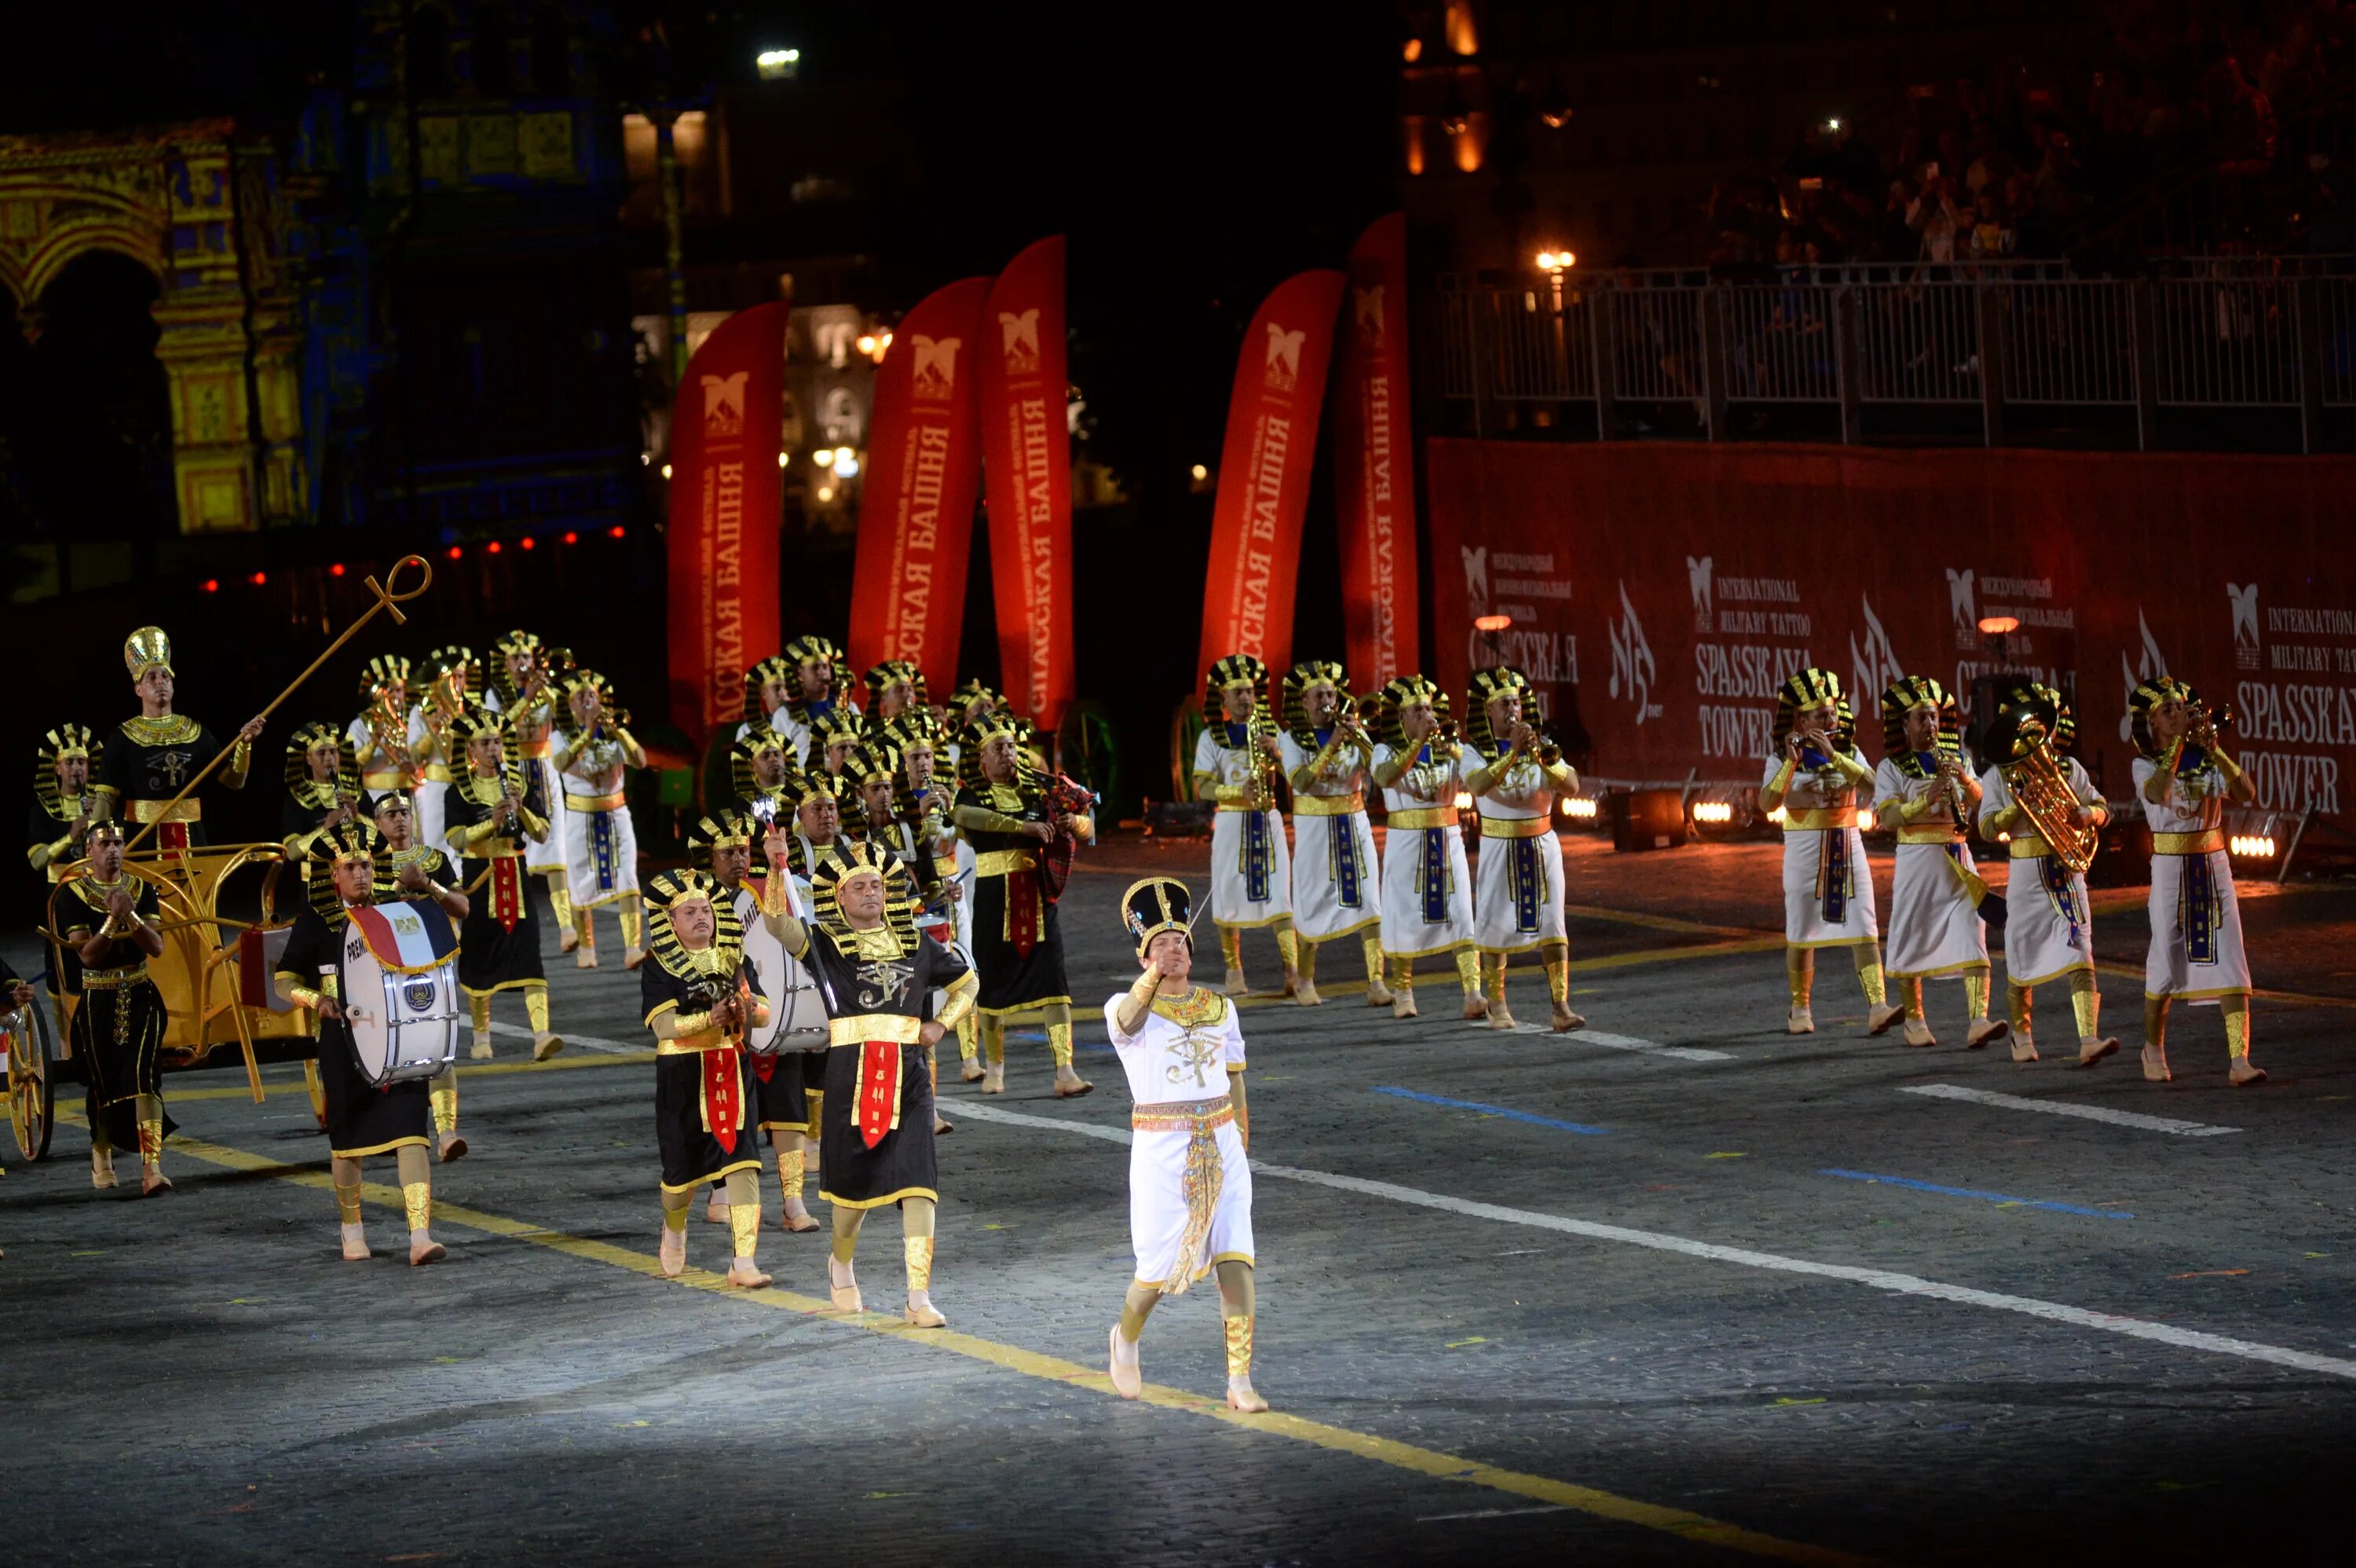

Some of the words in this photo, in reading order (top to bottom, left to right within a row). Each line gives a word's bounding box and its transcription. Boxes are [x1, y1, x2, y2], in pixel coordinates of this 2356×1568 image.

[908, 425, 949, 552] БАШНЯ
[1022, 398, 1052, 524] БАШНЯ
[1252, 413, 1290, 543] БАШНЯ
[1371, 376, 1391, 501] БАШНЯ
[716, 460, 744, 587] БАШНЯ
[1029, 535, 1052, 715] СПАССКАЯ
[1717, 576, 1800, 603] INTERNATIONAL
[1721, 609, 1768, 635] MILITARY
[1770, 612, 1811, 637] TATTOO
[2270, 644, 2330, 672] MILITARY
[1699, 704, 1774, 760] TOWER
[2238, 750, 2340, 816] TOWER
